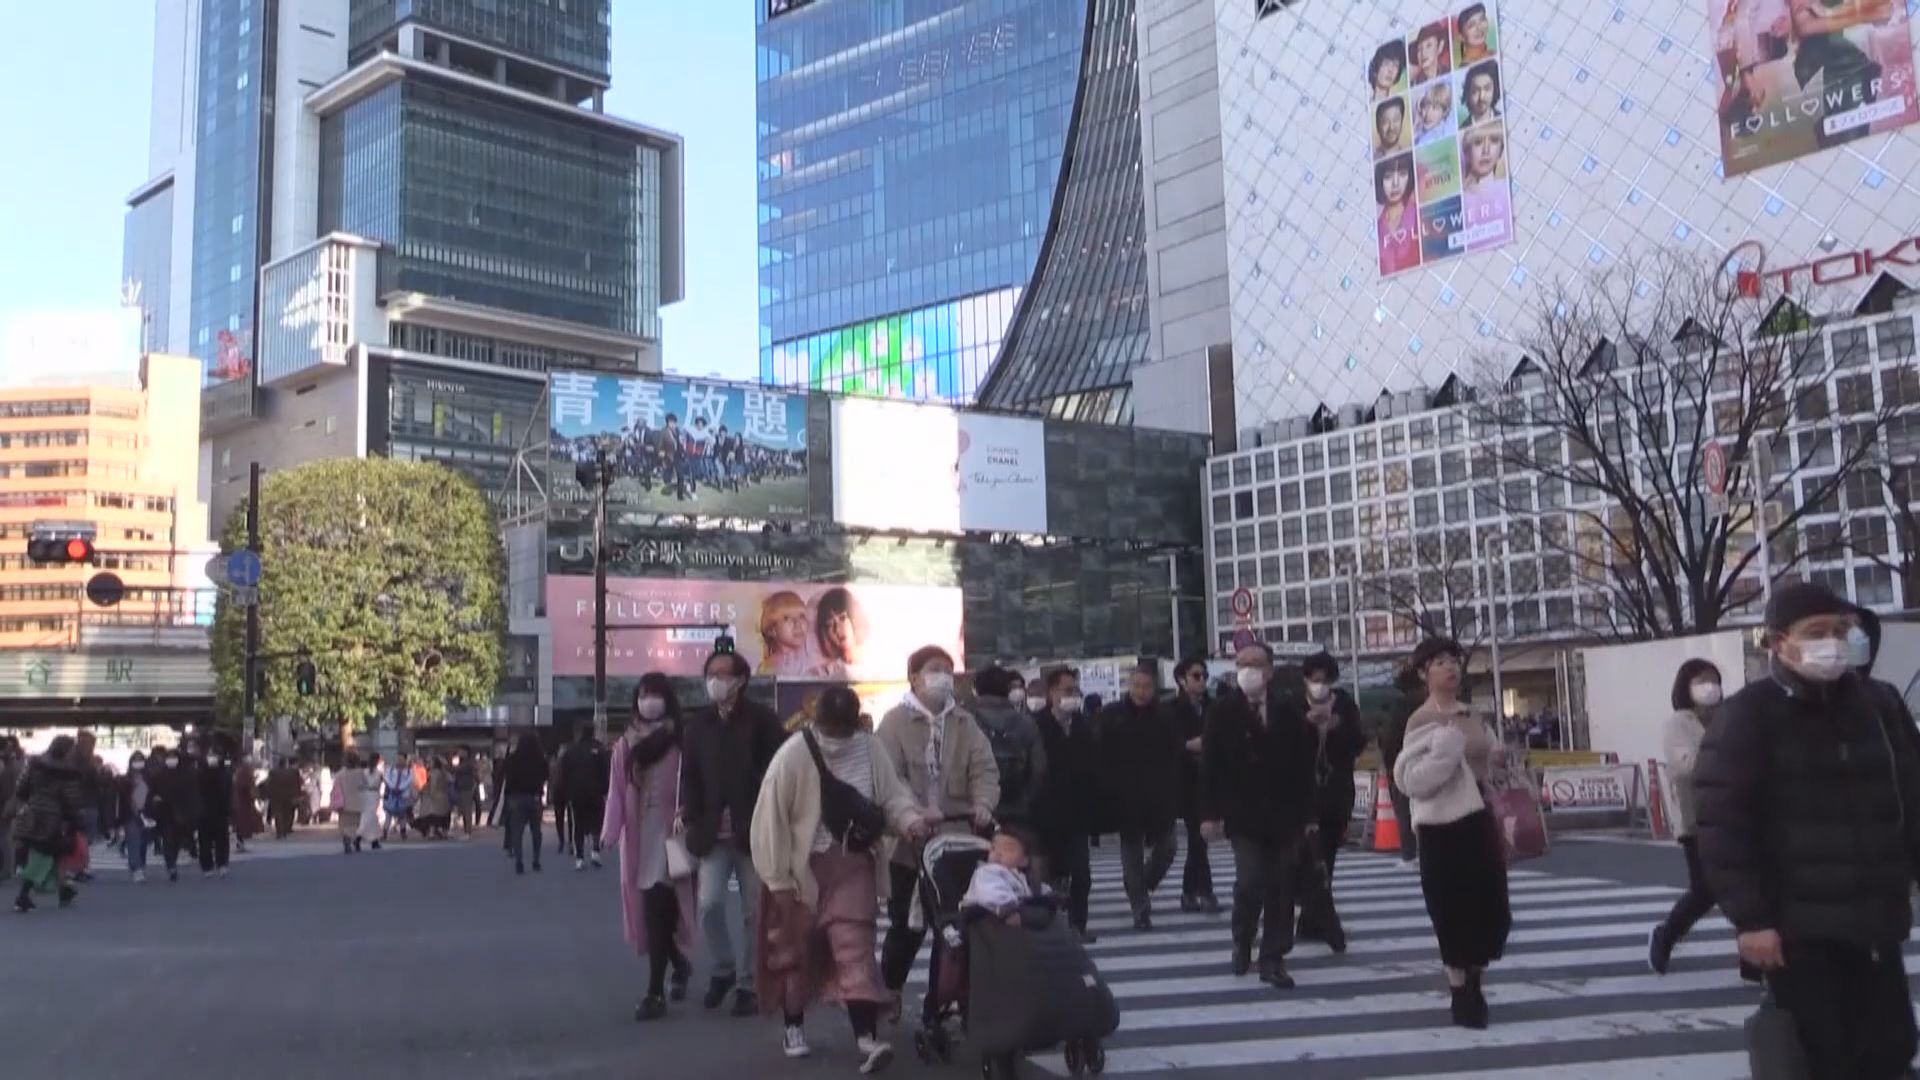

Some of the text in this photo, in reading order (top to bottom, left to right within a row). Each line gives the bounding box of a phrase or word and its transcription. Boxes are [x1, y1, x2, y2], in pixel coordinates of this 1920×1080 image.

[1762, 236, 1920, 293] TOK
[551, 372, 789, 441] 青春放題
[986, 456, 1019, 466] CHANEL
